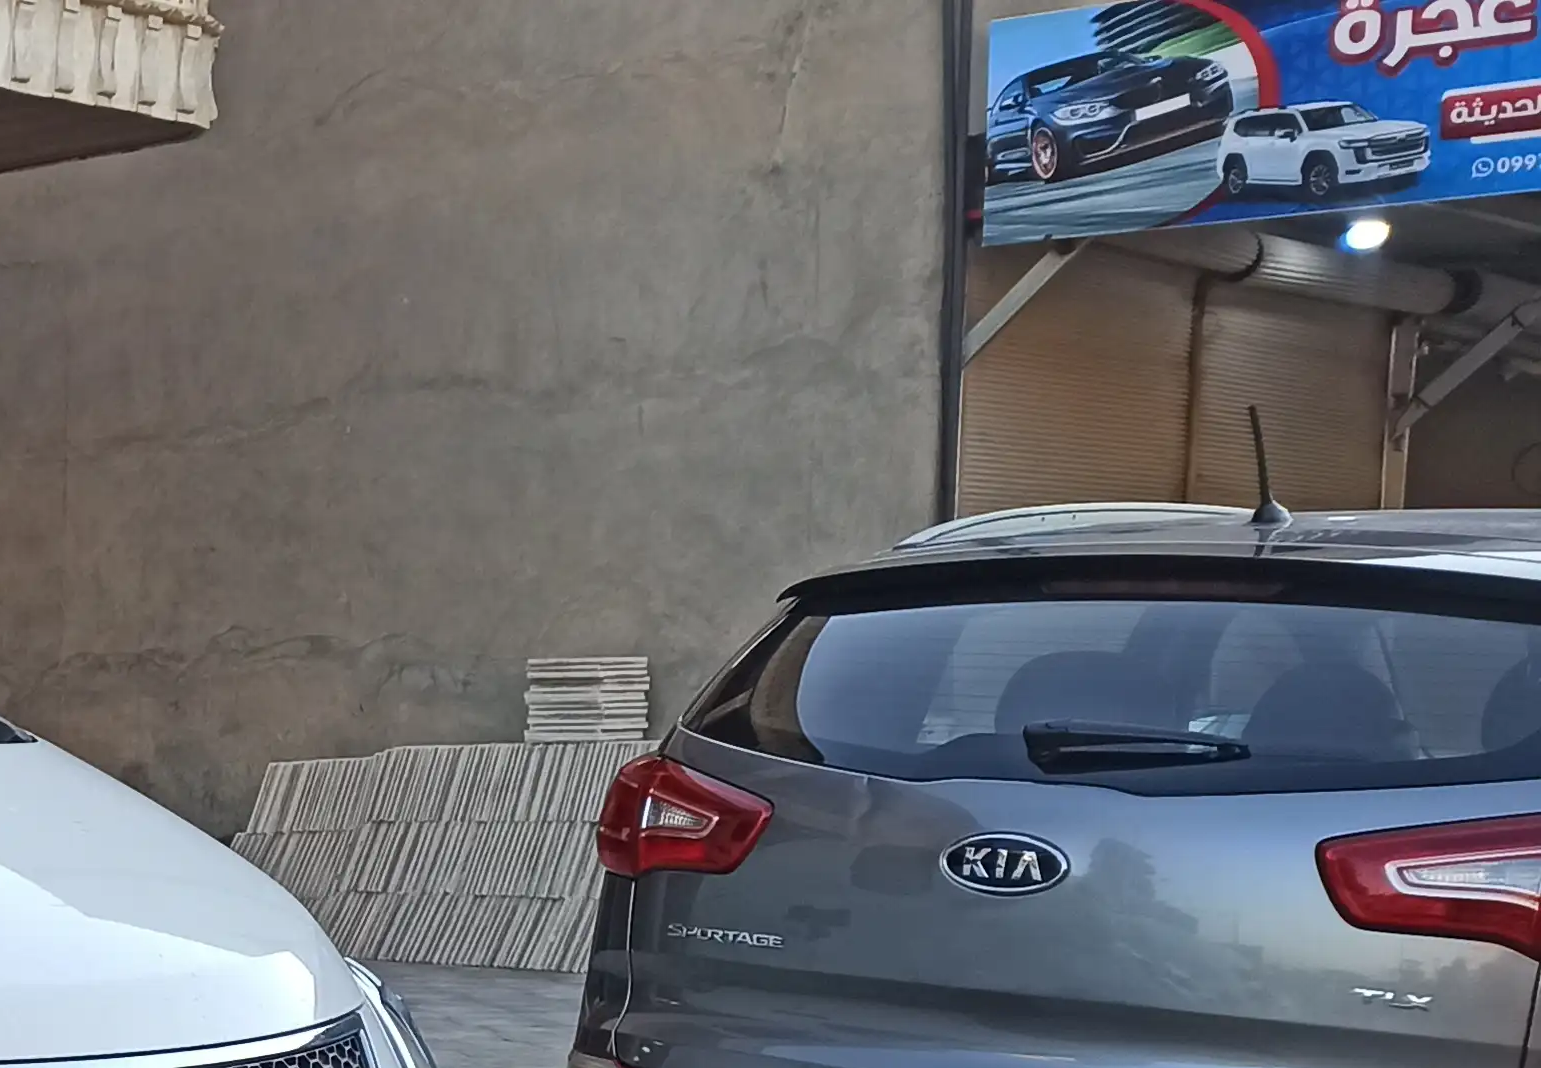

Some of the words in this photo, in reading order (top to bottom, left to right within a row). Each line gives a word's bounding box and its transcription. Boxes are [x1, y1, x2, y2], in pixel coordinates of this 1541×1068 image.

[1497, 153, 1541, 174] 099
[961, 846, 1043, 881] KIA
[667, 922, 785, 949] SPORTAGE
